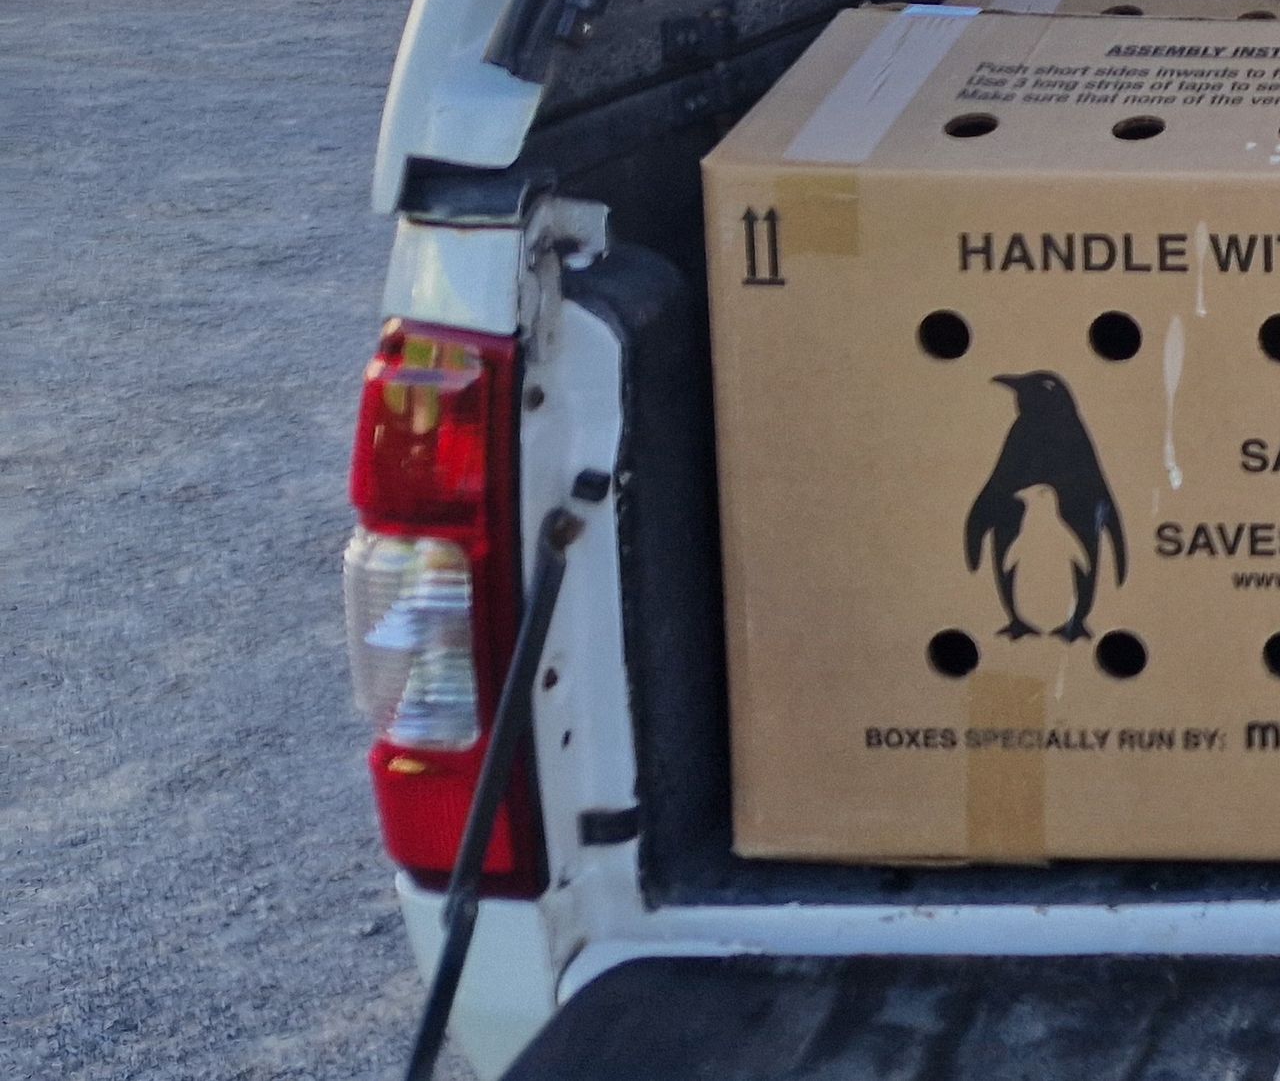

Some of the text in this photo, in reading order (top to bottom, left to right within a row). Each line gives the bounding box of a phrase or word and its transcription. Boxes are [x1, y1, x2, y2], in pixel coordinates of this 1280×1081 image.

[1105, 44, 1227, 59] ASSEMBLY
[975, 61, 1029, 75] Push
[1034, 64, 1089, 76] short
[1094, 65, 1149, 77] sides
[1156, 66, 1239, 79] inwards
[1247, 69, 1267, 79] to
[965, 75, 1007, 88] Use
[1015, 77, 1028, 88] 3
[1033, 77, 1080, 92] long
[1085, 78, 1144, 93] strips
[1151, 79, 1172, 91] of
[1178, 80, 1224, 94] tape
[1231, 82, 1249, 92] to
[957, 88, 1016, 101] Make
[1022, 92, 1069, 103] sure
[1077, 92, 1119, 104] that
[1124, 94, 1177, 105] none
[1182, 93, 1204, 105] of
[1209, 93, 1243, 105] the
[958, 233, 1189, 272] HANDLE
[865, 727, 957, 750] BOXES
[965, 727, 1111, 751] SPECIALLY
[1117, 727, 1174, 751] RUN
